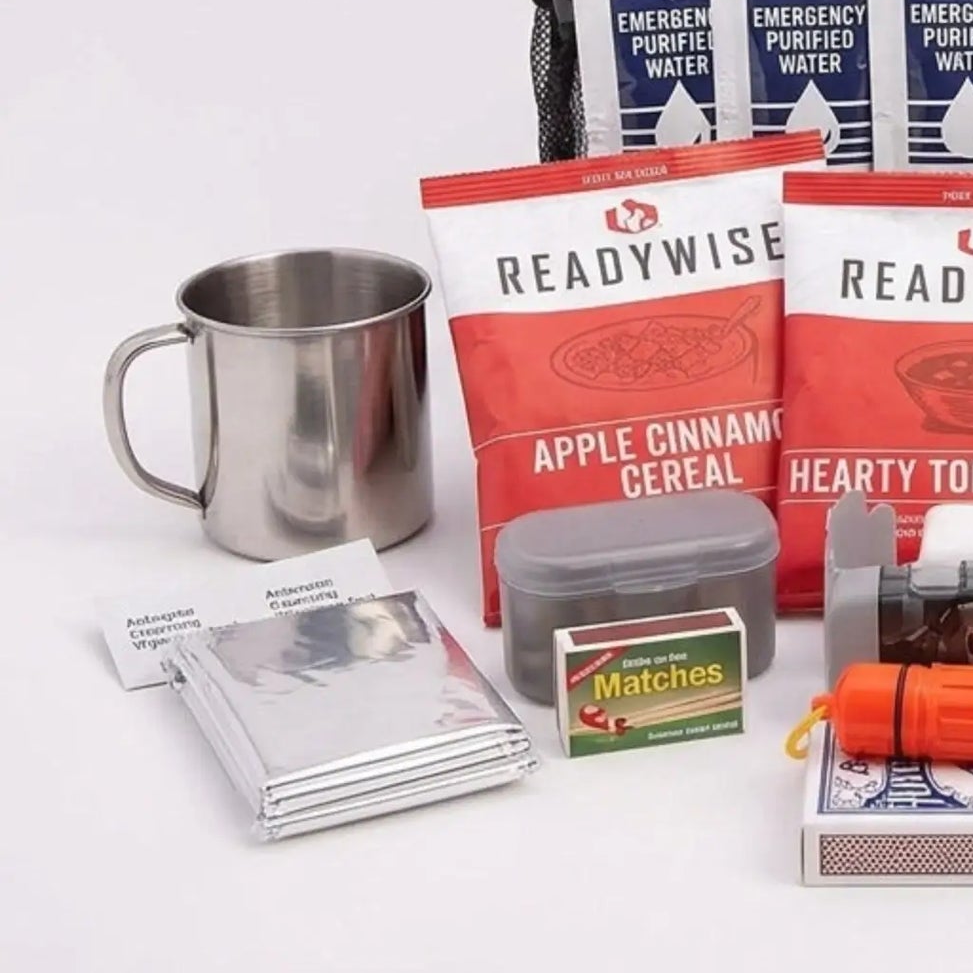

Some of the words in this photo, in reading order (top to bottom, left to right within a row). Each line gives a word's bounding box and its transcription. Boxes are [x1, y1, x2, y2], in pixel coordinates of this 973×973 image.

[617, 7, 712, 33] EMERGEN
[753, 4, 866, 27] EMERGENCY
[766, 28, 855, 51] PURIFIED
[644, 54, 710, 79] WATER
[778, 52, 842, 74] WATER
[496, 221, 785, 295] READYWISE
[533, 426, 638, 475] APPLE
[620, 451, 744, 500] CEREAL
[789, 457, 917, 495] HEARTY
[593, 662, 724, 701] Matches
